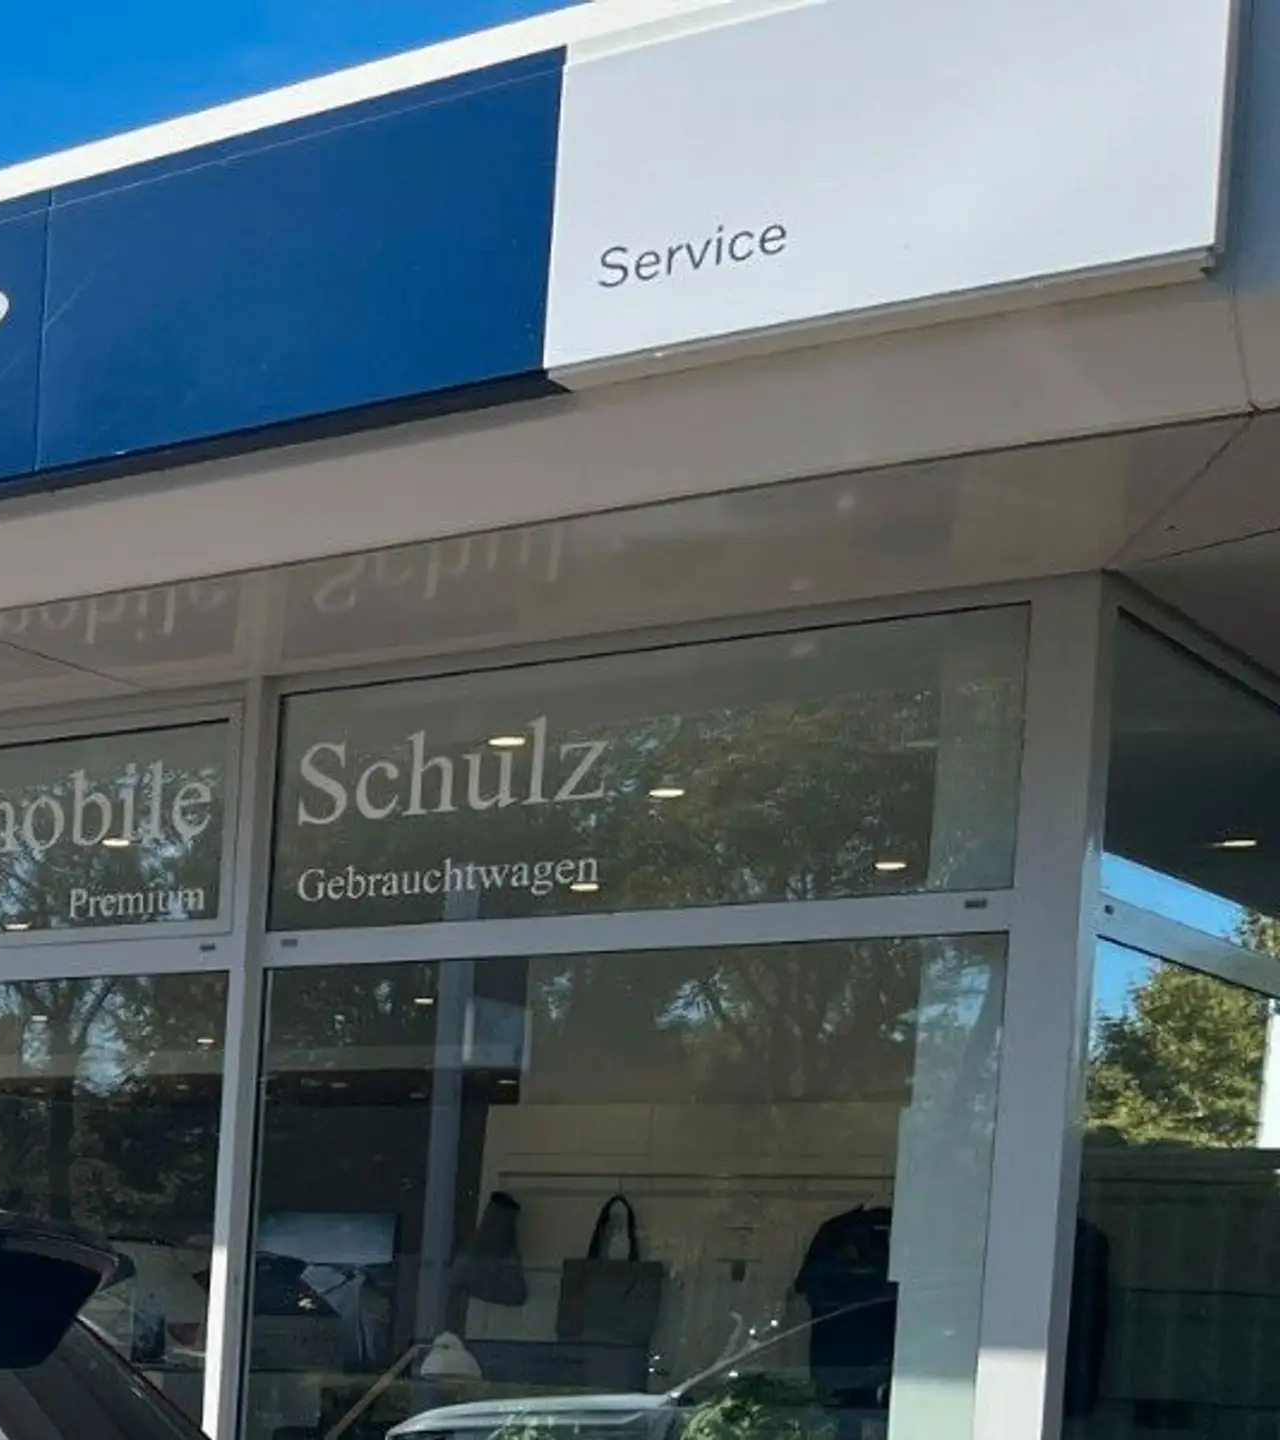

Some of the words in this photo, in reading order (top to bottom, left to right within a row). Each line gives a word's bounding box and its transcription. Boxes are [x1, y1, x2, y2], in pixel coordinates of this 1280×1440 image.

[598, 219, 788, 288] Service
[297, 716, 612, 827] Schulz
[68, 886, 206, 920] Premium
[297, 856, 600, 905] Gebrauchtwagen
